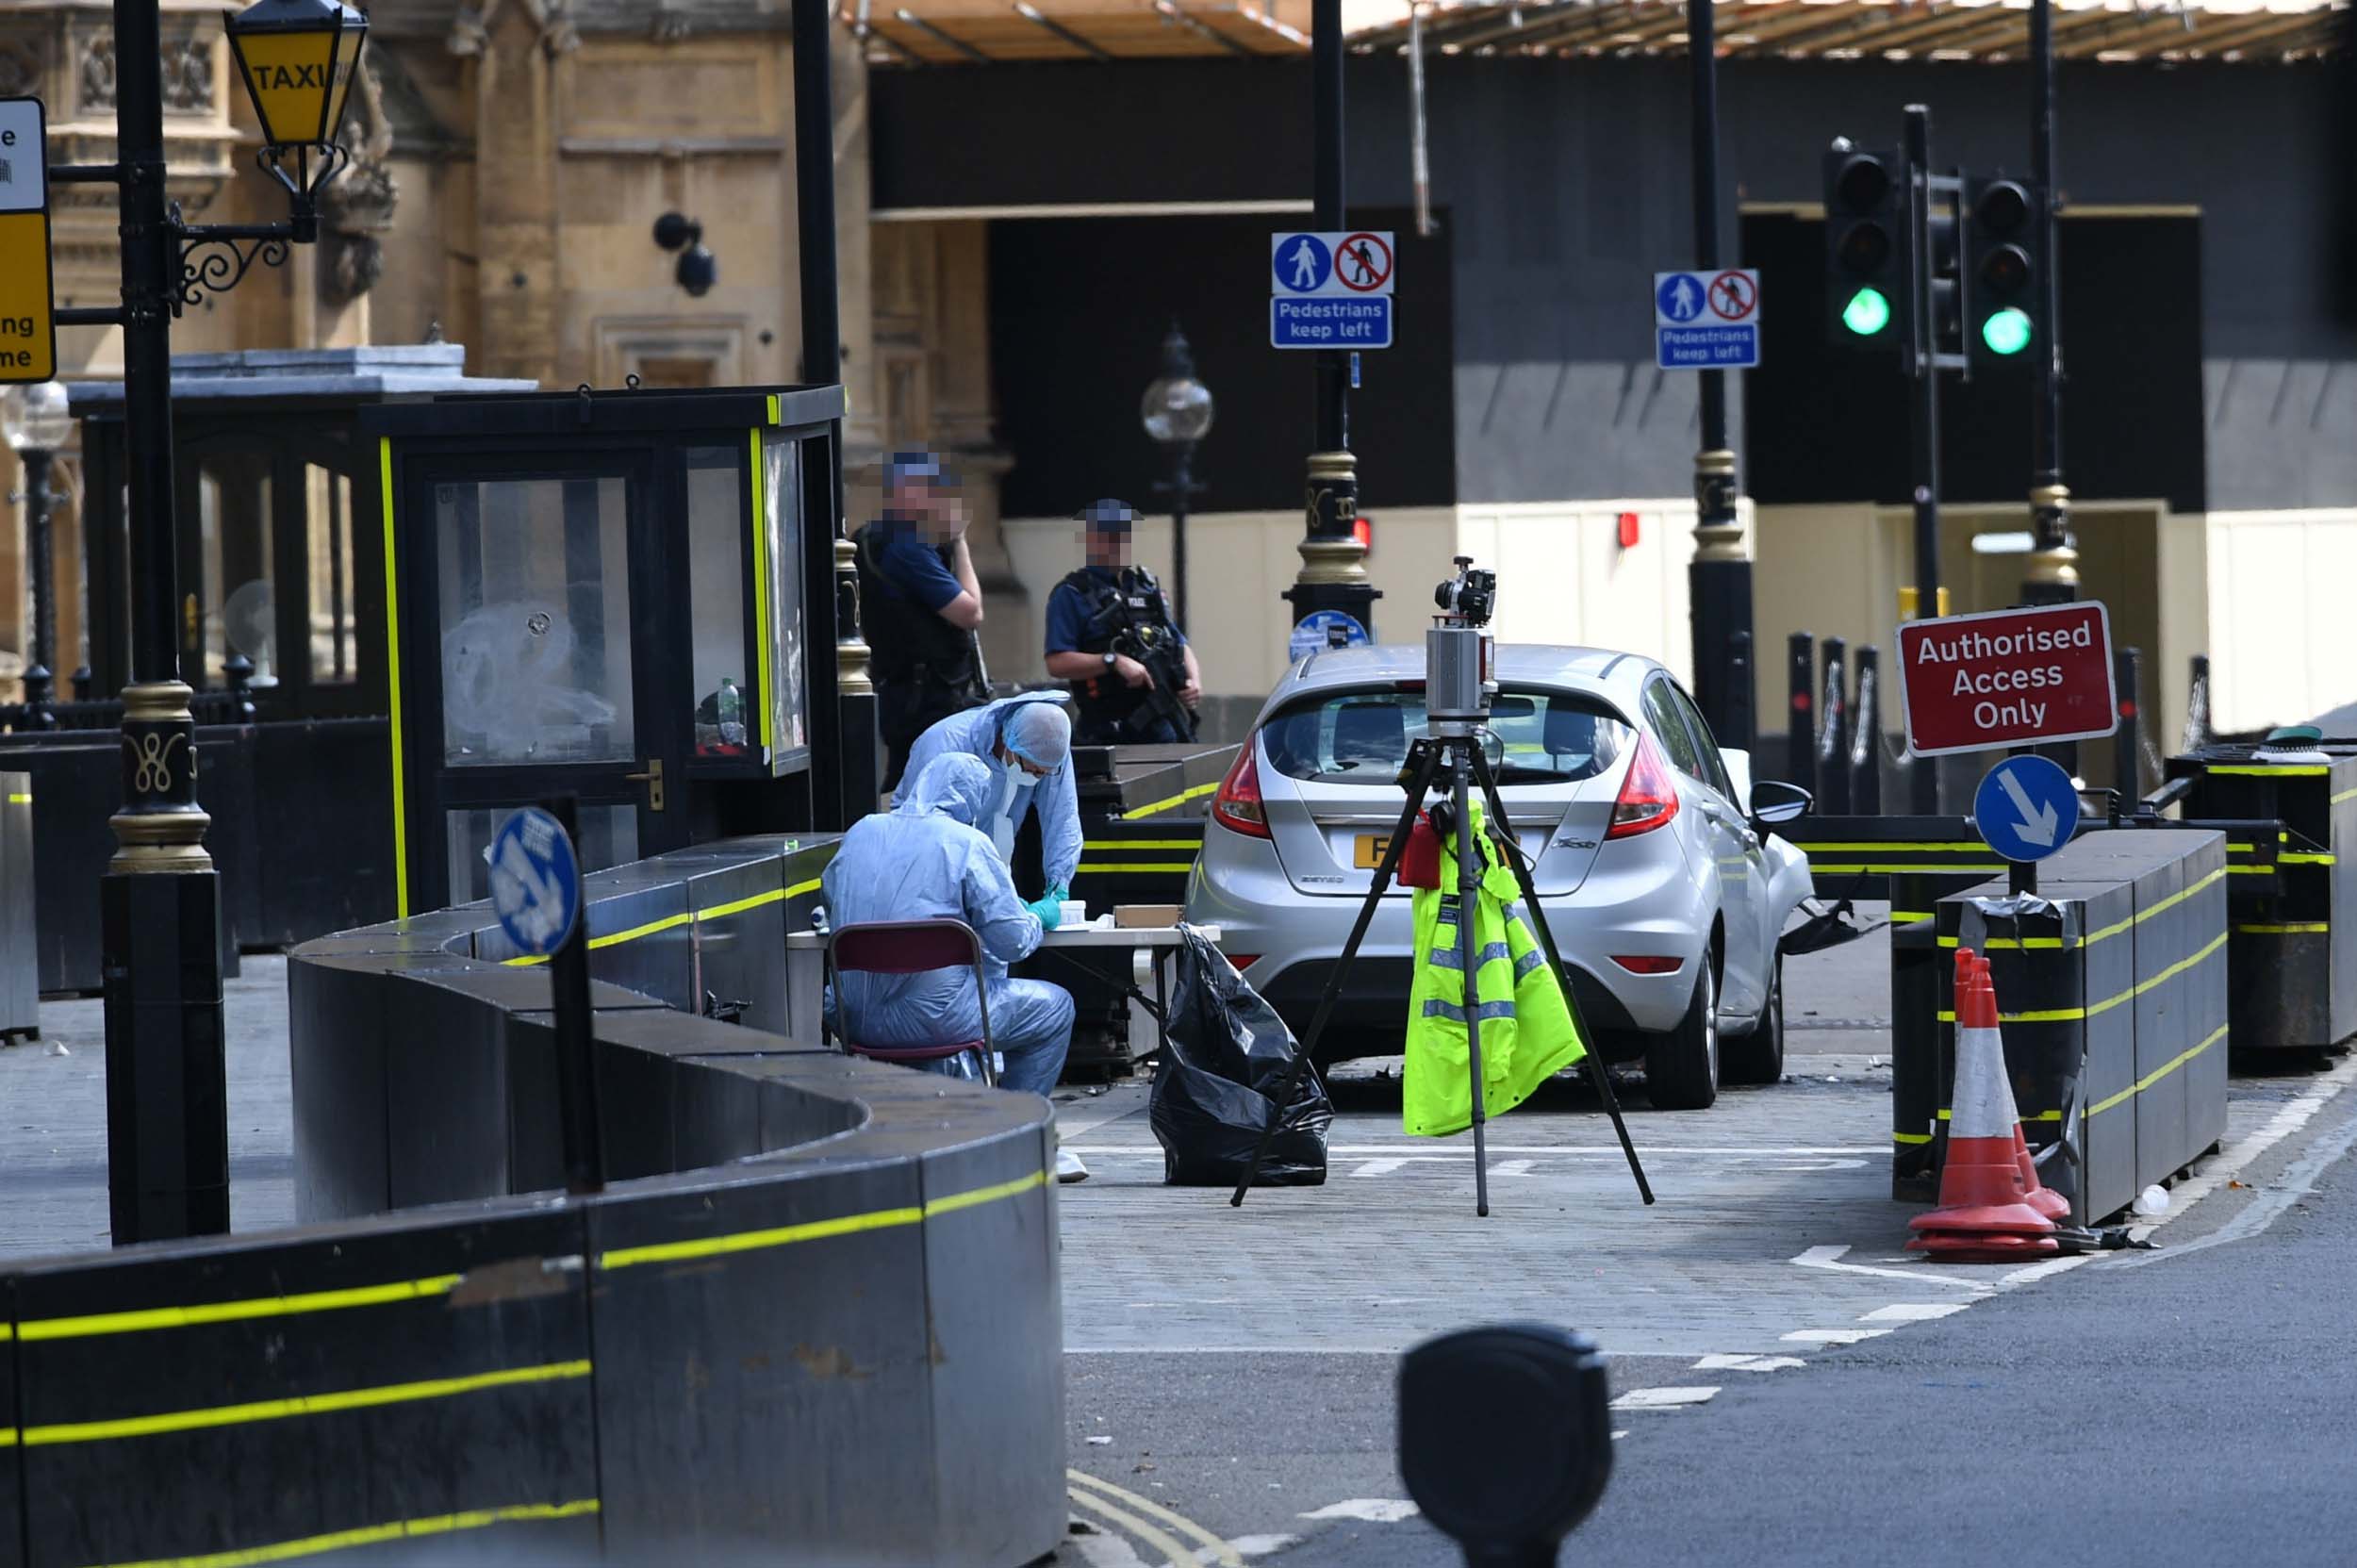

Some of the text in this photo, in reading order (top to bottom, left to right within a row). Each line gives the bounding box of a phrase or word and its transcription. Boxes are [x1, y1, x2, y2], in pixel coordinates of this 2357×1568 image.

[253, 63, 325, 90] TAXI
[1279, 302, 1382, 318] Pedestrians
[1290, 322, 1372, 339] keep left
[1663, 330, 1751, 344] Pedestrians
[1673, 345, 1742, 361] keep left
[1918, 619, 2092, 665] Authorised
[1953, 665, 2064, 696] Access
[1973, 698, 2047, 729] Only
